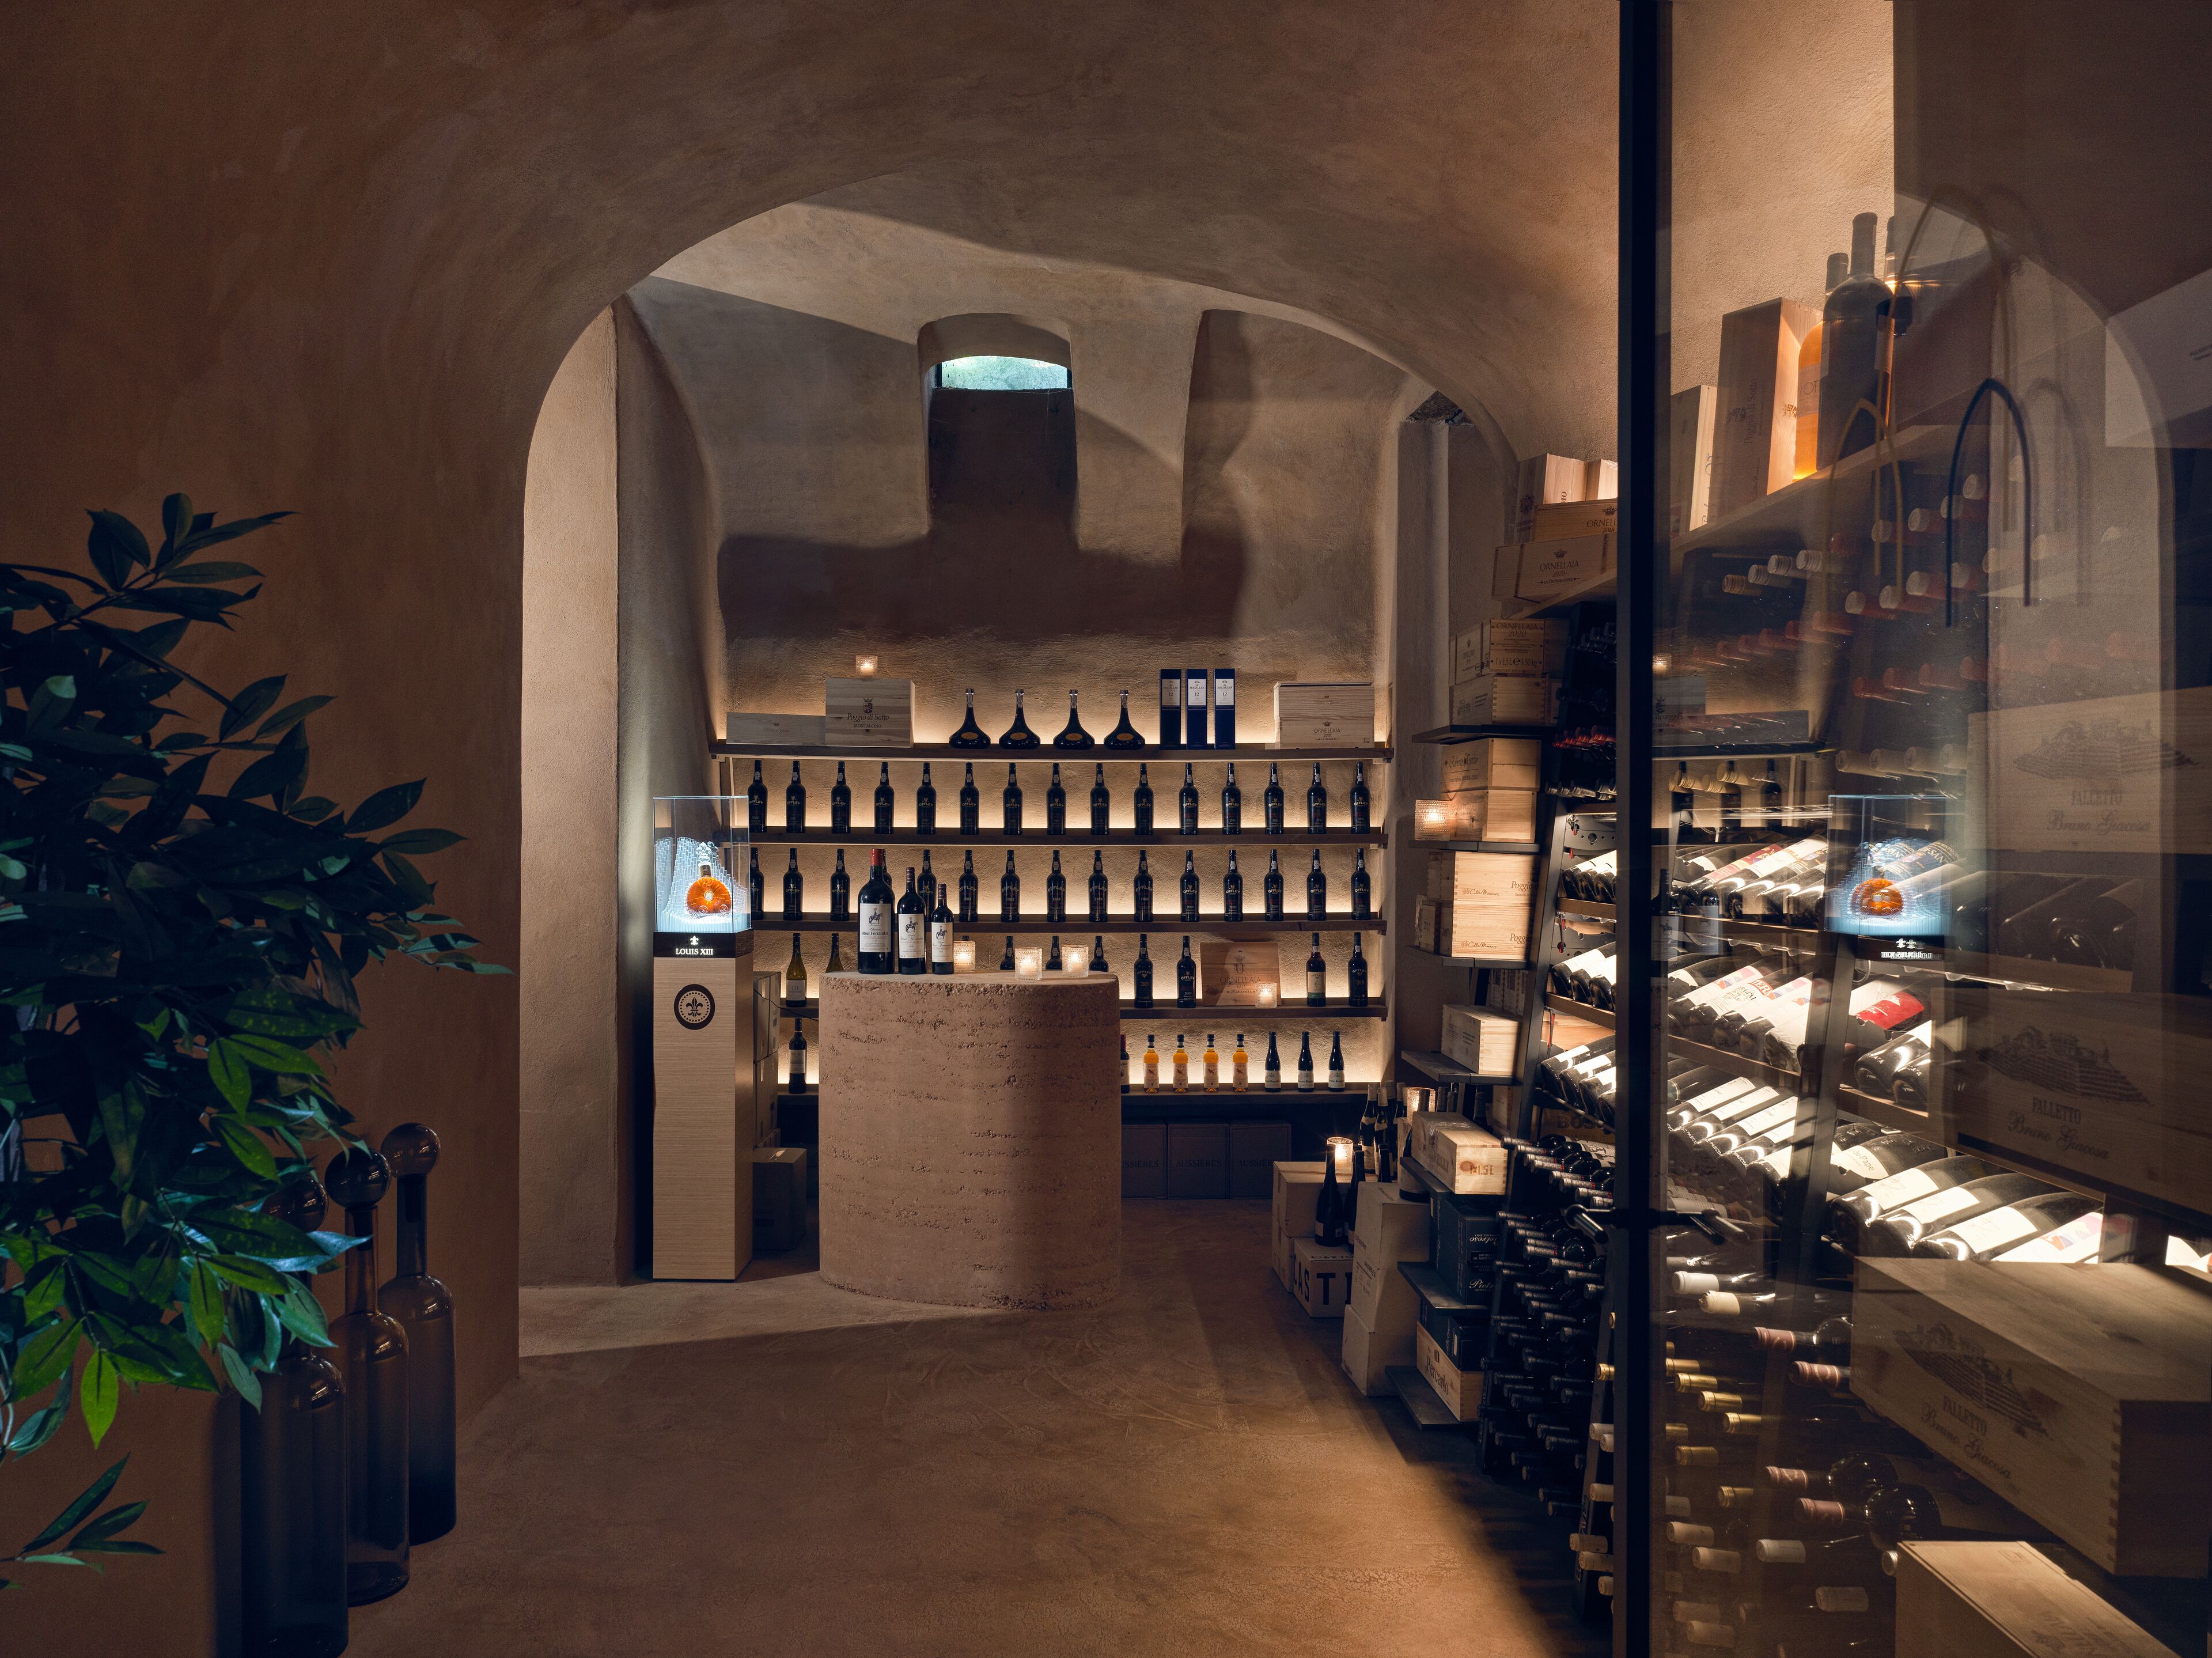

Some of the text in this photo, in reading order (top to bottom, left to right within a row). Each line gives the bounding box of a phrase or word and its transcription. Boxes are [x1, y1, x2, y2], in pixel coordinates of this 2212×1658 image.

[1539, 560, 1580, 571] ORNELLAIA
[1495, 622, 1539, 630] ORNELLAIA
[847, 713, 866, 722] Poggio
[1511, 881, 1533, 892] Poggio
[1219, 976, 1262, 985] ORNELLAIA
[1123, 1158, 1160, 1168] SSIÈRES
[1426, 1354, 1449, 1395] Percarlo
